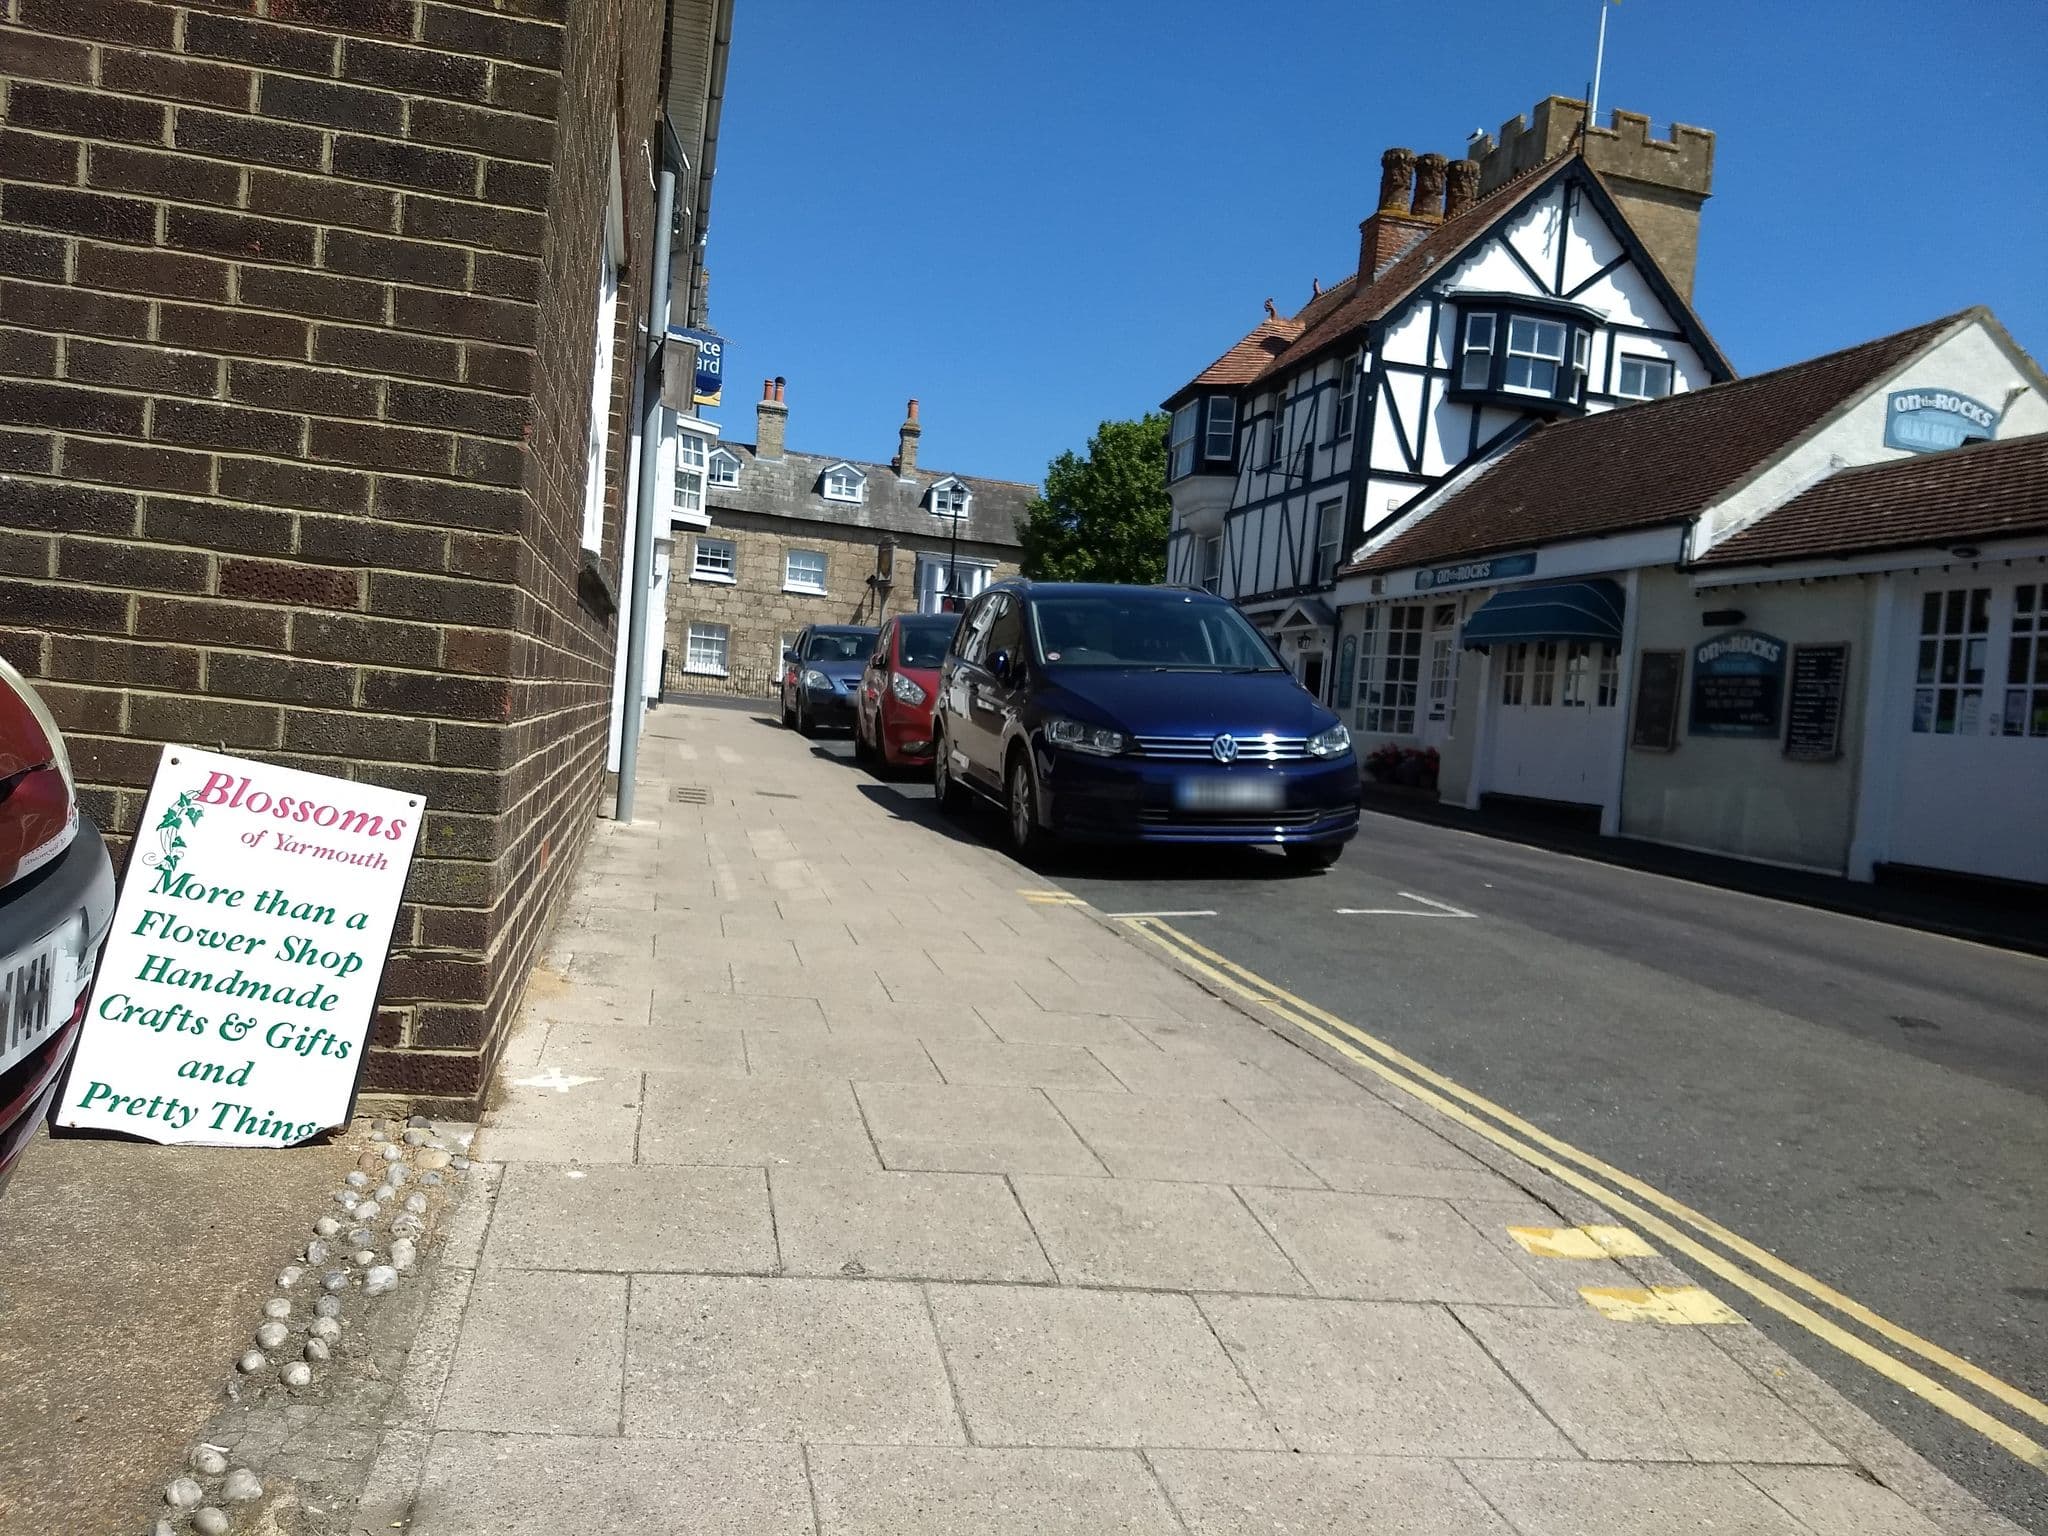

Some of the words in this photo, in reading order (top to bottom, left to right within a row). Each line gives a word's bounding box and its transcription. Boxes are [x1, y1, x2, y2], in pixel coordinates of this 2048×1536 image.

[1921, 396, 1936, 407] the
[1935, 394, 1993, 427] ROCKS
[1457, 562, 1491, 581] ROCKS
[195, 770, 408, 842] Blossoms
[240, 829, 269, 848] of
[272, 832, 389, 871] Yarmouth
[148, 868, 245, 908] More
[255, 889, 336, 926] than
[345, 911, 369, 931] a
[131, 909, 266, 956] Flower
[275, 935, 364, 979] Shop
[135, 954, 339, 1012] Handmade
[98, 993, 209, 1037] Crafts
[218, 1012, 257, 1041] &
[265, 1021, 353, 1060] Gifts
[177, 1059, 255, 1087] and
[77, 1081, 199, 1129] Pretty
